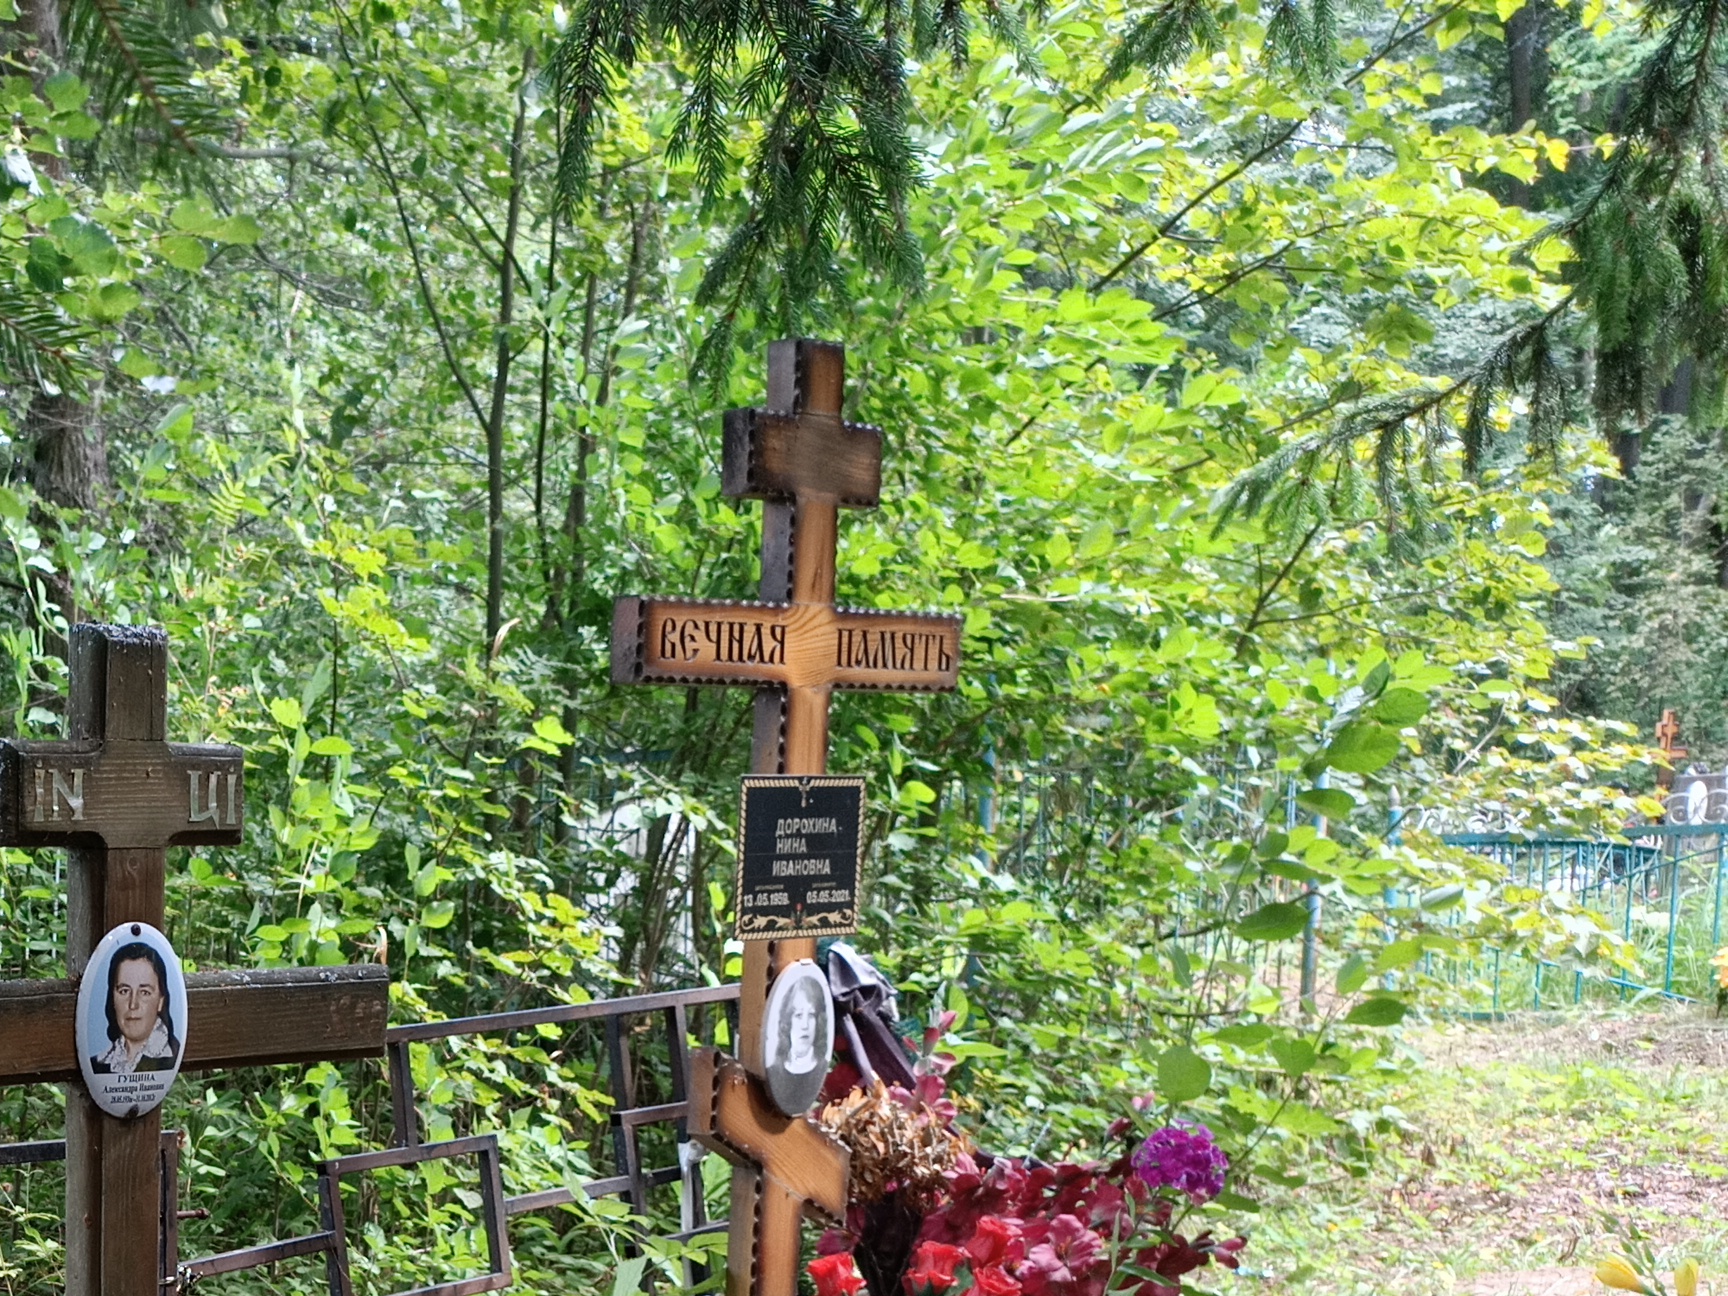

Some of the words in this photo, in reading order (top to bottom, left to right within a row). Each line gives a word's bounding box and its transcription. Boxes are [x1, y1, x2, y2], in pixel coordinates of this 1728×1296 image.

[659, 617, 787, 665] ВЕЧНАЯ
[835, 627, 952, 673] ПАМЯТЬ
[775, 817, 837, 838] ДОРОХИНА
[776, 837, 808, 855] НИНА
[772, 859, 831, 876] ИВАНОВНА
[118, 1074, 155, 1083] ГУЩИНА
